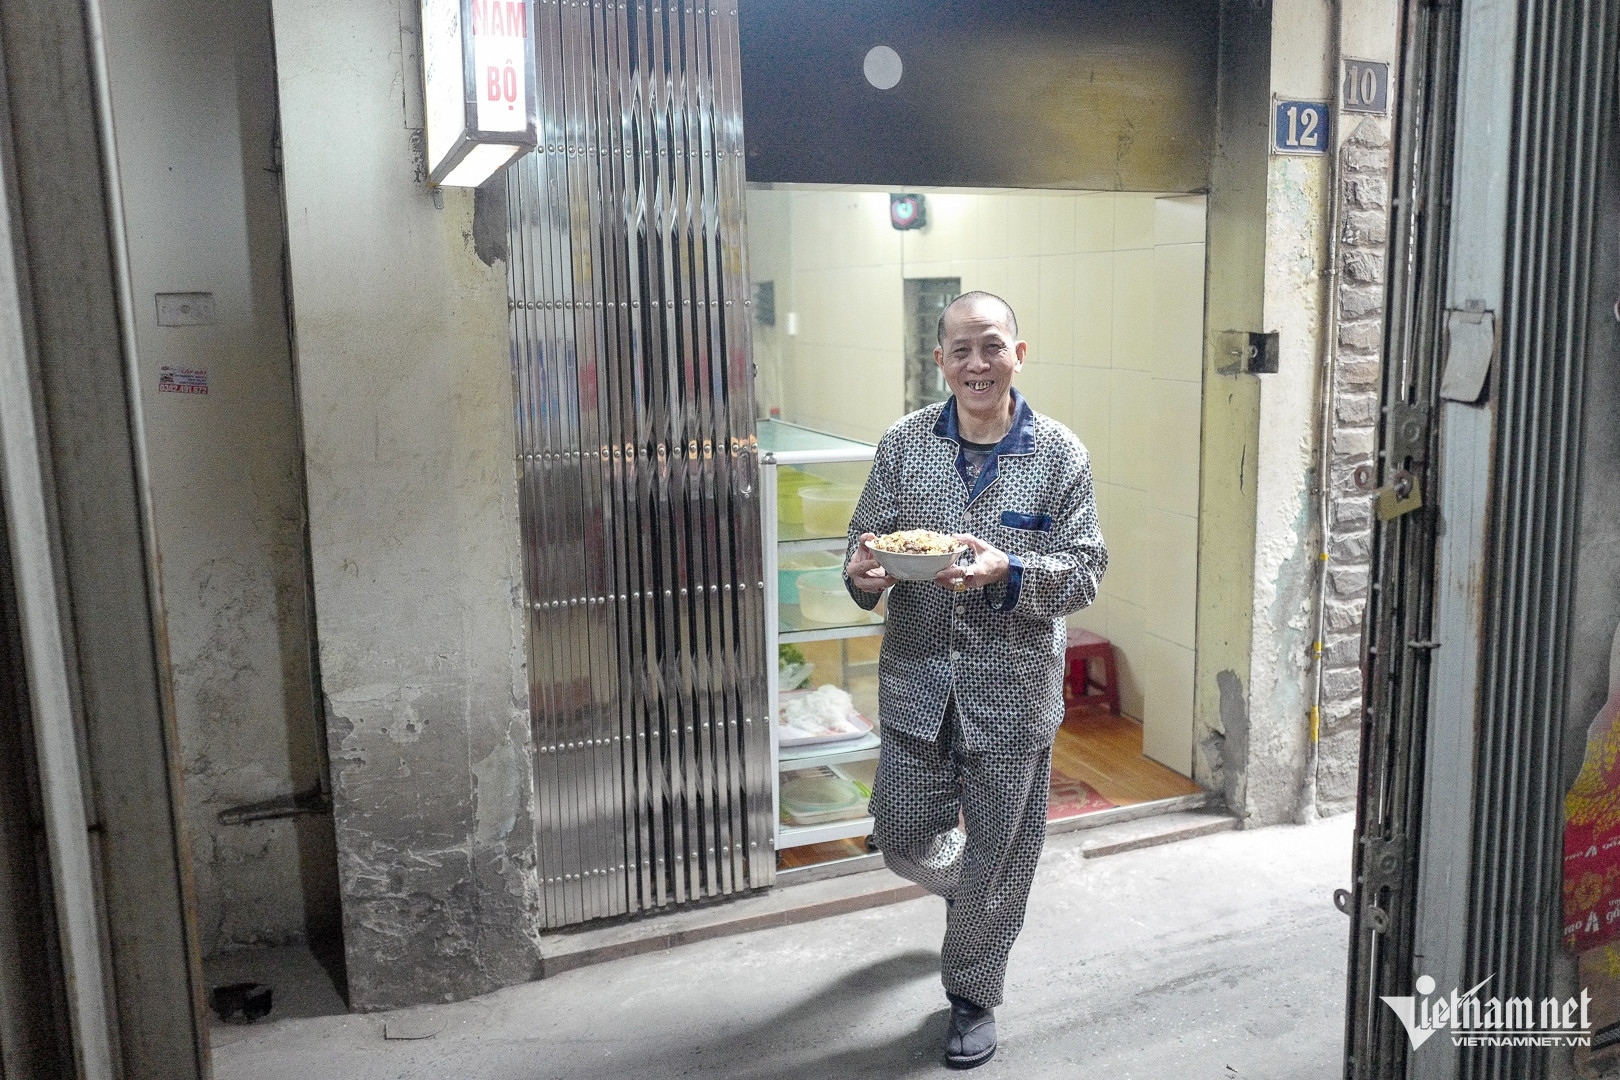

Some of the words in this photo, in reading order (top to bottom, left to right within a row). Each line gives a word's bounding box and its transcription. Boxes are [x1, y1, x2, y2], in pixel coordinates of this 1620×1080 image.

[472, 0, 527, 38] NAM
[487, 58, 517, 111] BỘ
[1347, 66, 1377, 105] 10
[1286, 106, 1319, 146] 12
